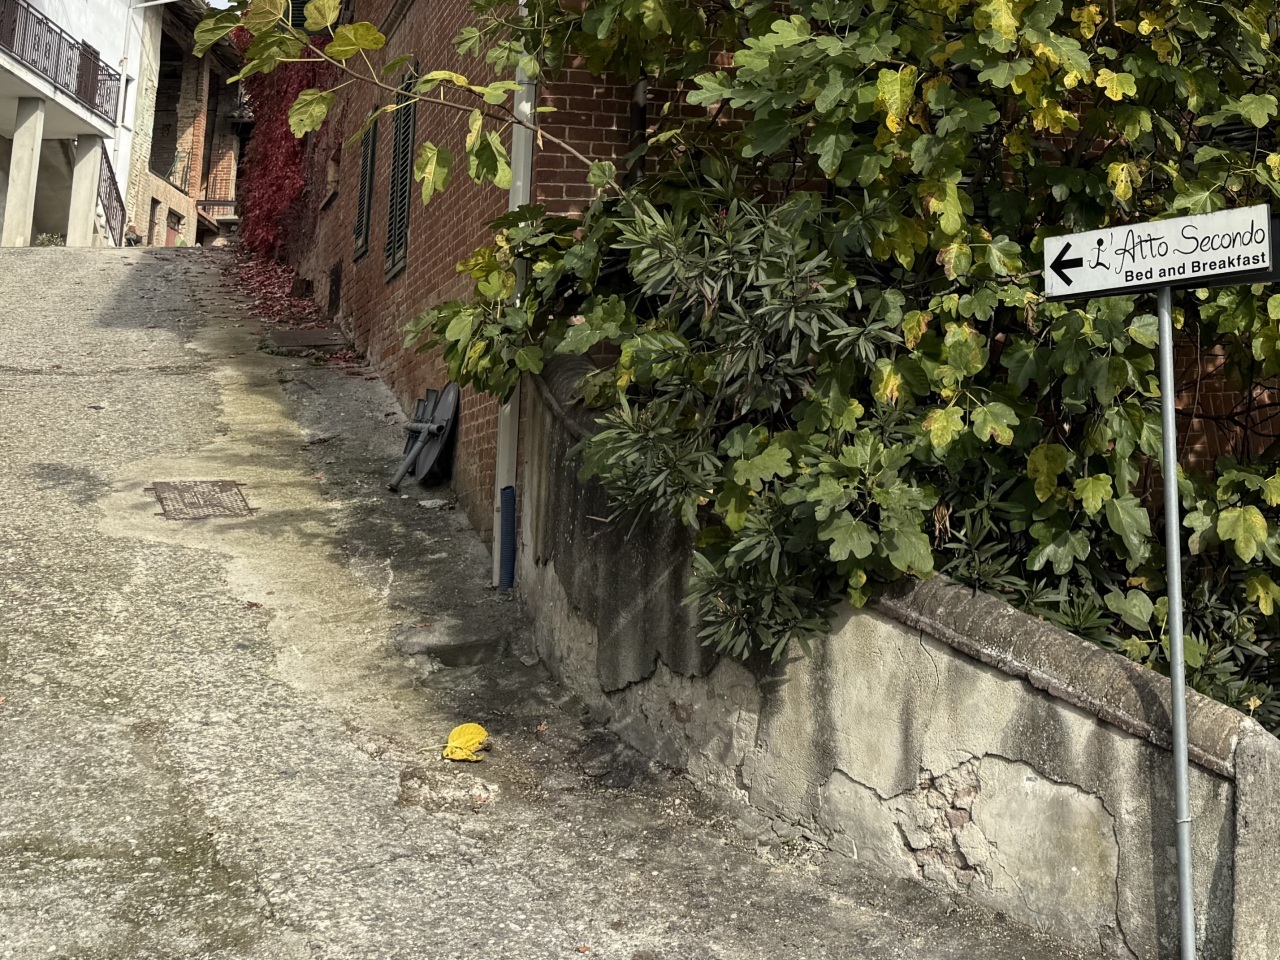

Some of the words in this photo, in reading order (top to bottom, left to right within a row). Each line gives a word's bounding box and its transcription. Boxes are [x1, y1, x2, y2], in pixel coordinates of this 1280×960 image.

[1173, 219, 1266, 255] Secondo
[1125, 267, 1153, 282] Bed
[1158, 261, 1186, 278] and
[1191, 251, 1266, 273] Breakfast
